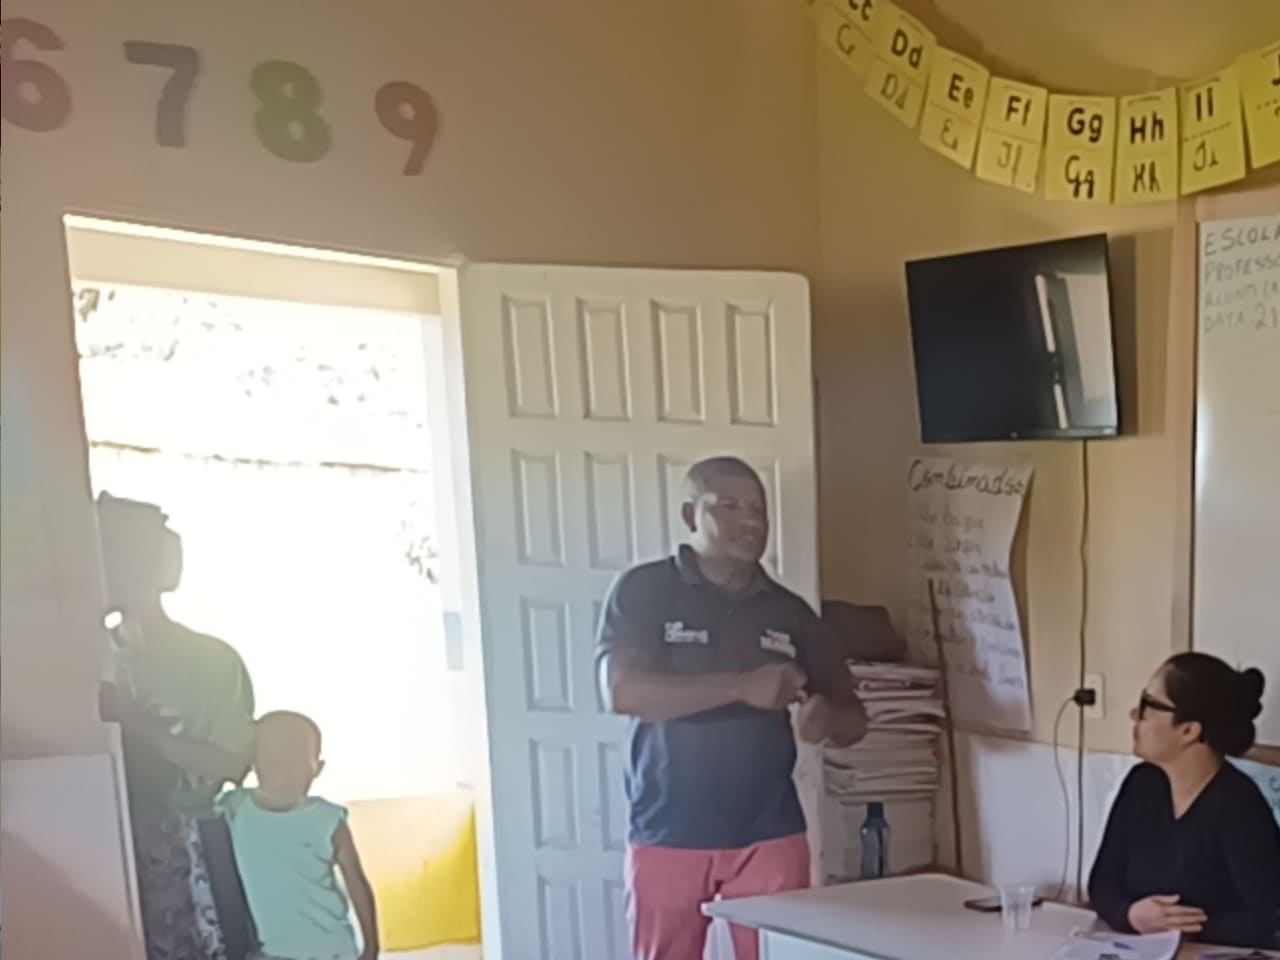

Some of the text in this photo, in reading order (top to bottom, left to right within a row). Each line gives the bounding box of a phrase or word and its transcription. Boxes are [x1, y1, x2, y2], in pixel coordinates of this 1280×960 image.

[890, 28, 924, 69] Dd
[0, 17, 440, 176] 6 7 8 9
[947, 72, 975, 109] Ee
[1066, 106, 1104, 144] Gg
[1129, 110, 1165, 145] Hh
